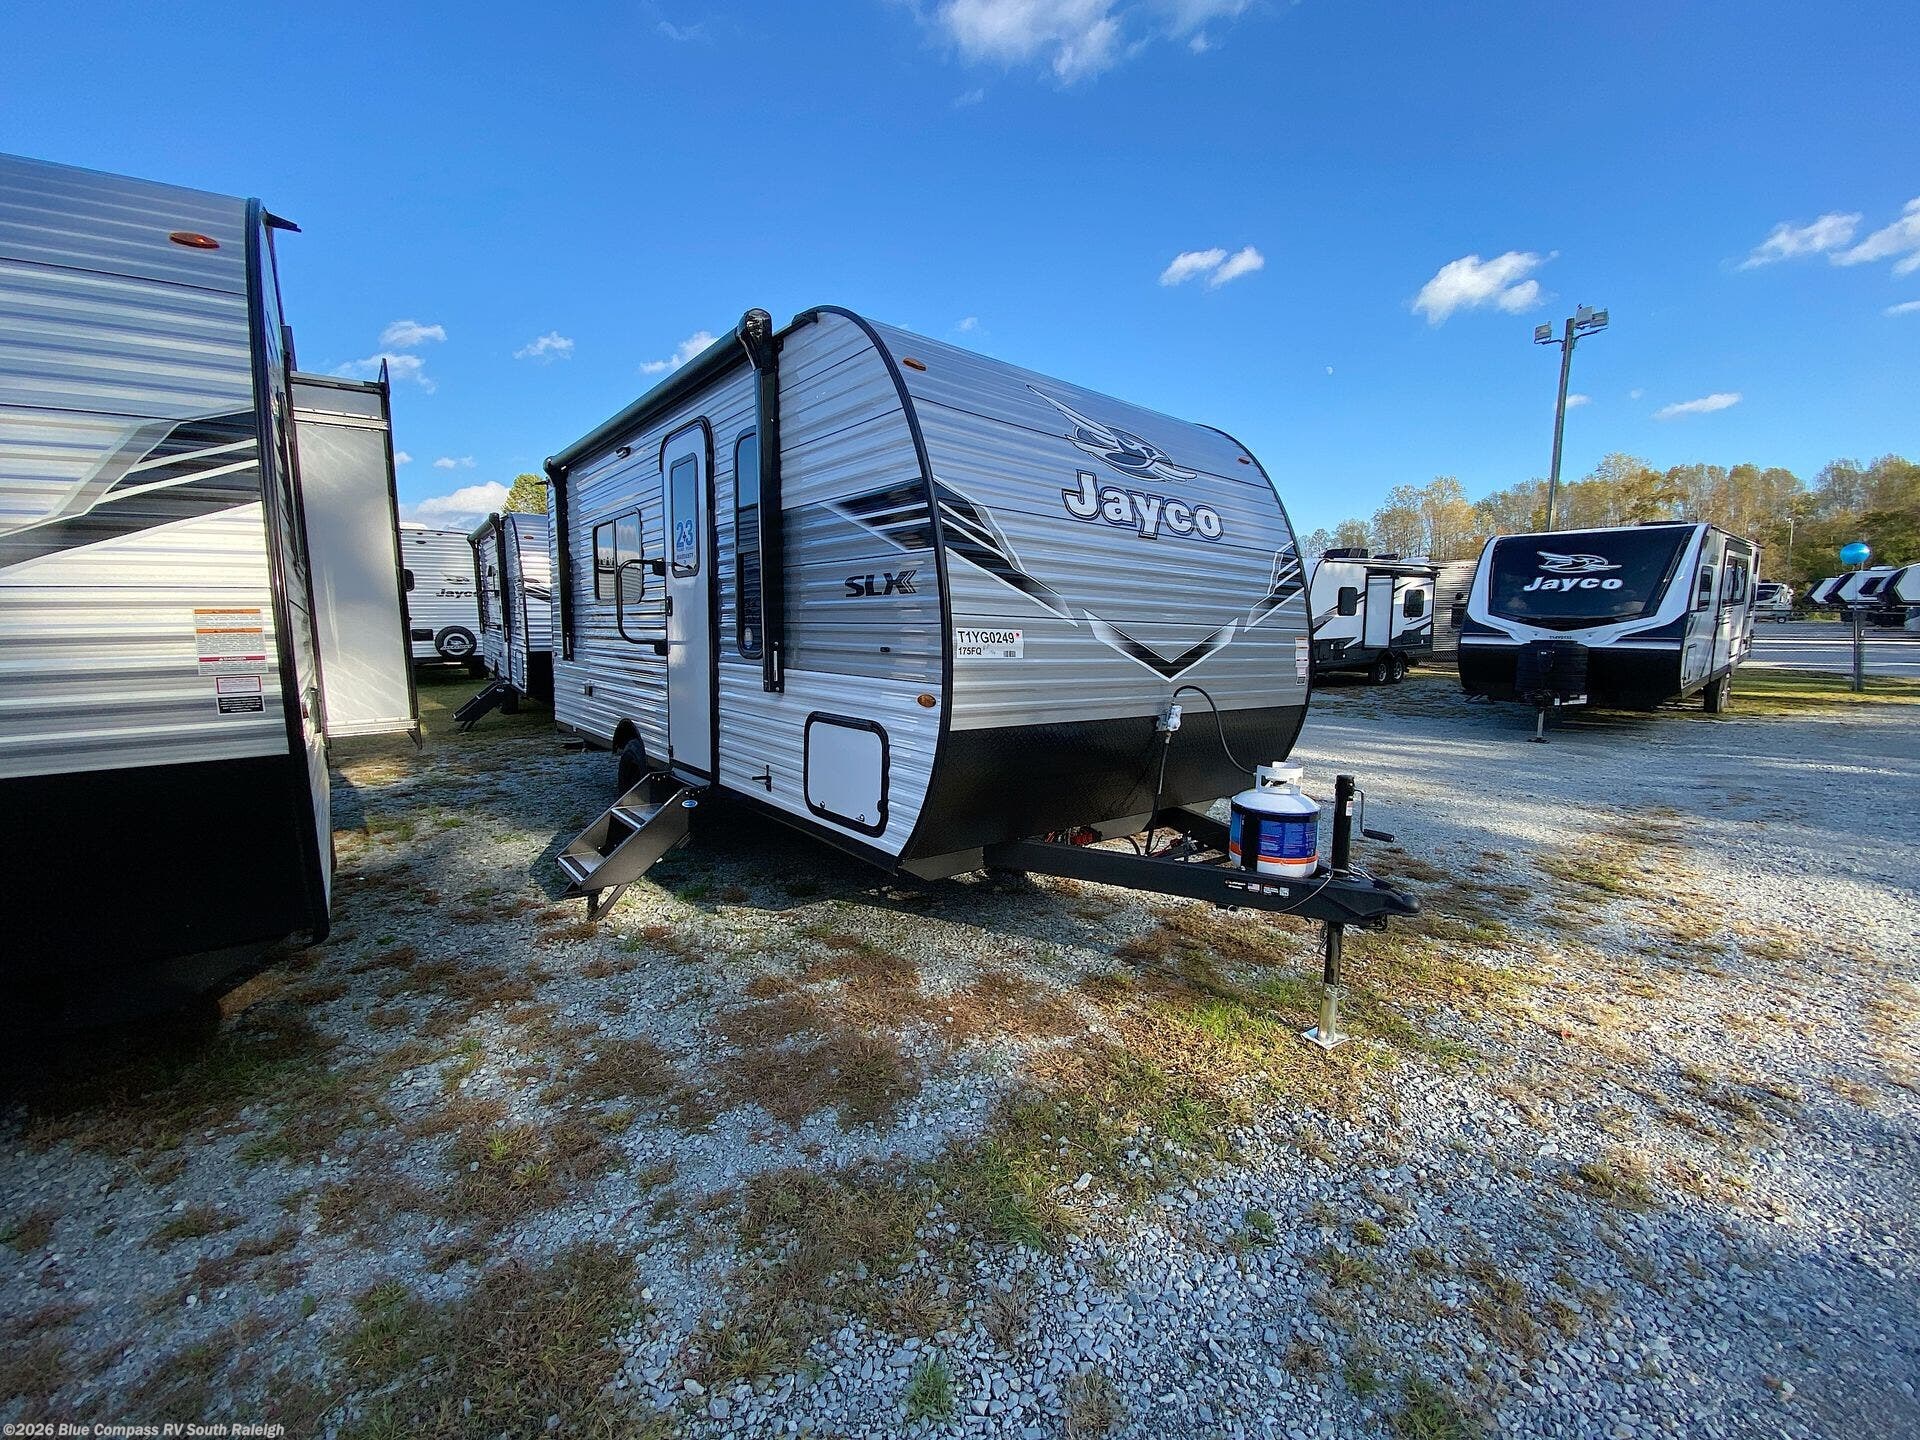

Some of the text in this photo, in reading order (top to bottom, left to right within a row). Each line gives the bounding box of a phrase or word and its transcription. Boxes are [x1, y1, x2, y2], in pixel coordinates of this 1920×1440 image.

[1062, 469, 1224, 541] Jayco
[845, 570, 917, 597] SLX
[1523, 576, 1623, 592] Jayco
[957, 631, 1015, 643] T1YG0249
[958, 647, 982, 655] 175FQ
